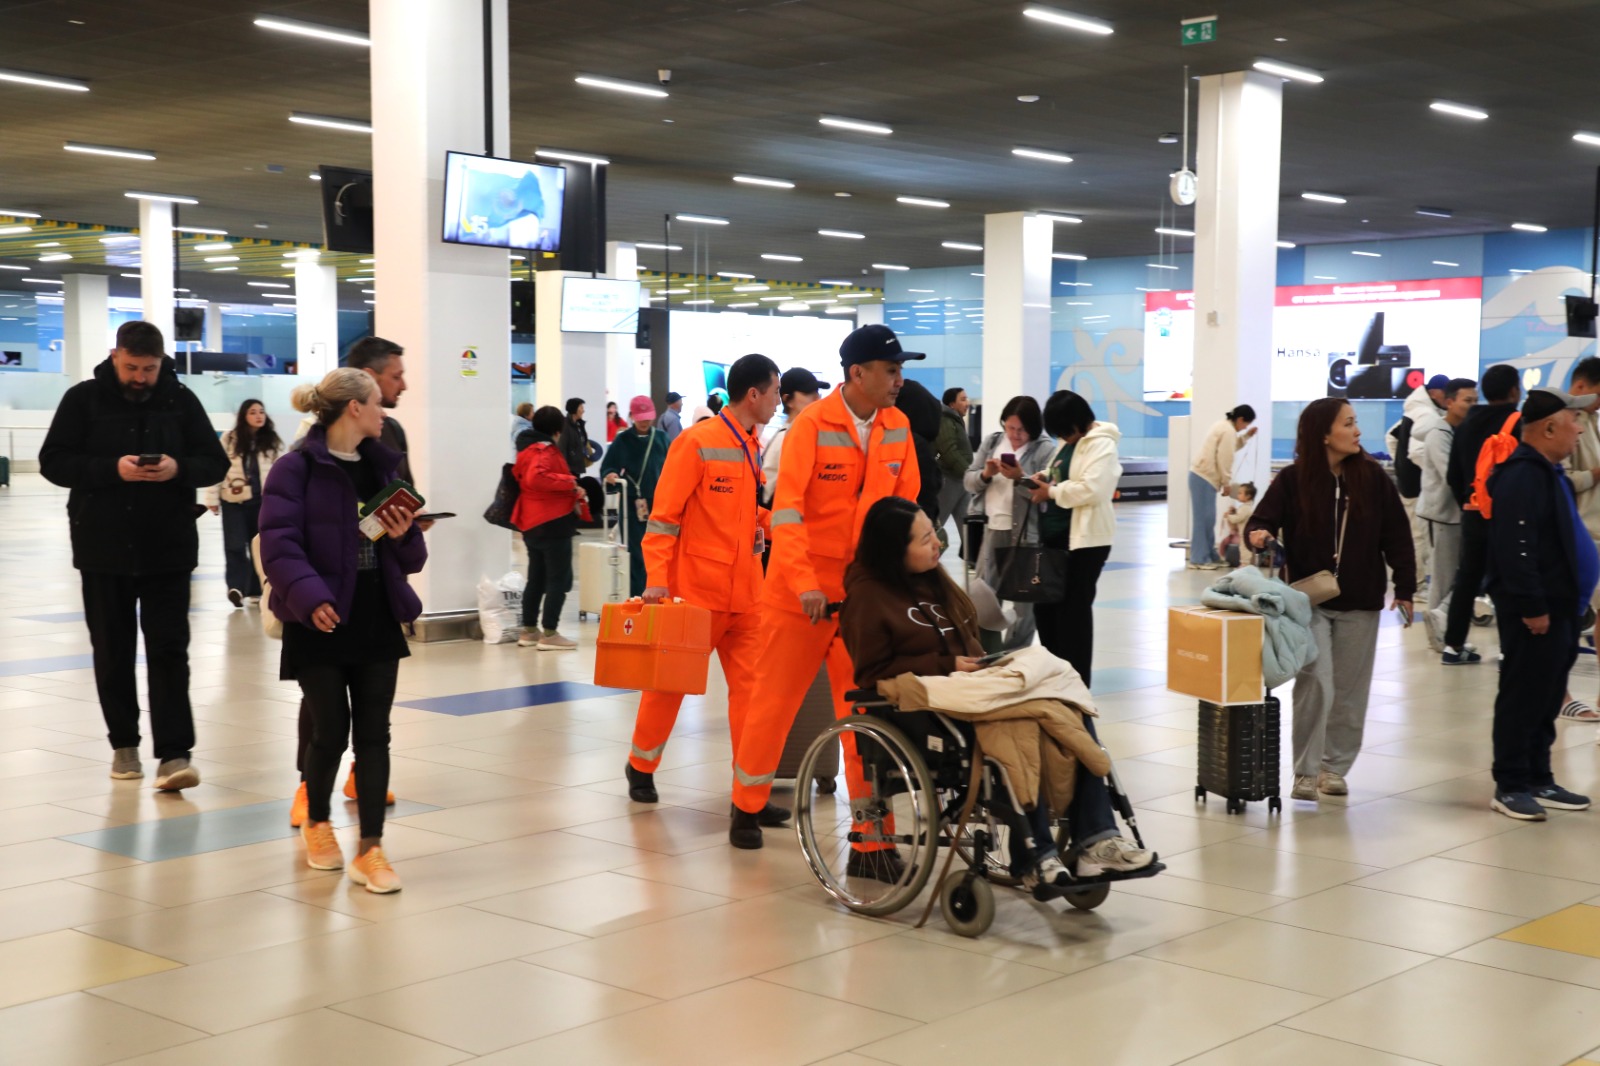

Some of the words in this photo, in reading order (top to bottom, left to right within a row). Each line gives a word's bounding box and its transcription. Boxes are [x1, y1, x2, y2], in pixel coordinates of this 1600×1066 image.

[1277, 347, 1320, 358] Hansa
[817, 472, 848, 482] MEDIC
[709, 484, 734, 494] MEDIC
